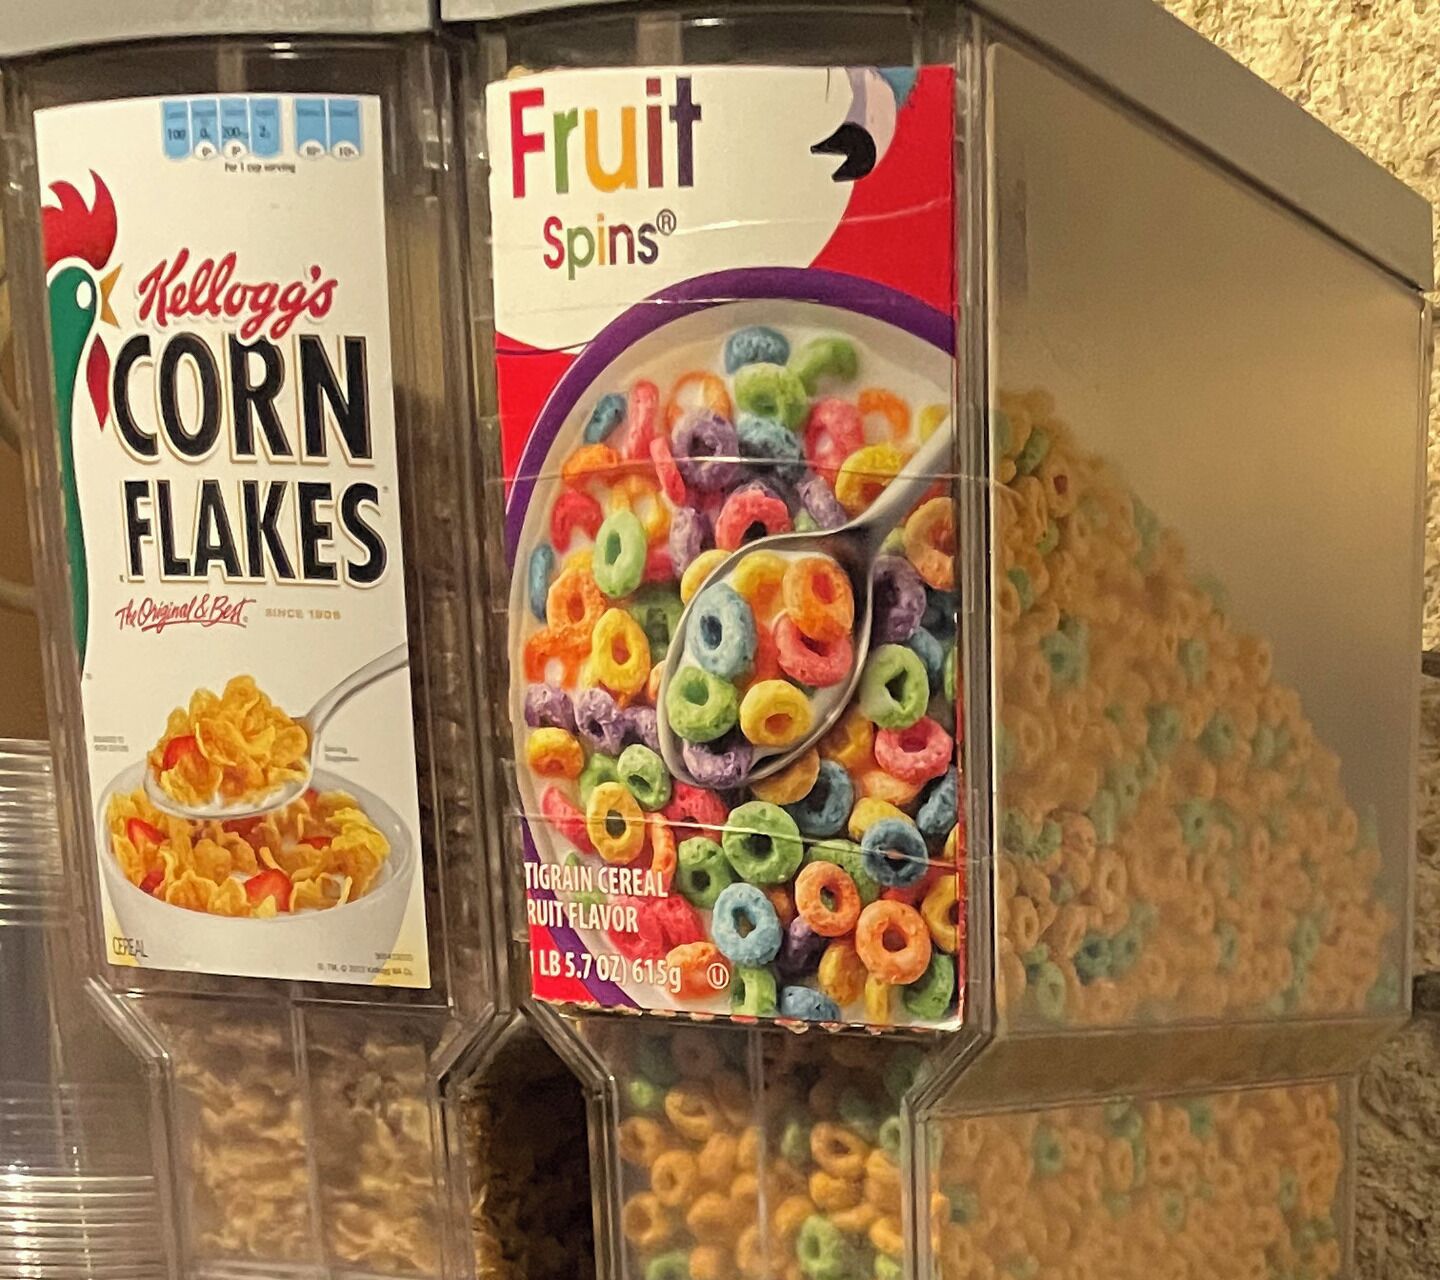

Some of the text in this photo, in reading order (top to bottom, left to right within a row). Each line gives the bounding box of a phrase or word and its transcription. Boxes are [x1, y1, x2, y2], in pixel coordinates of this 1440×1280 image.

[509, 76, 701, 198] Fruit
[139, 247, 338, 339] Kellogg's
[114, 333, 374, 460] CORN
[123, 479, 389, 584] FLAKES
[137, 594, 198, 633] Original
[194, 593, 211, 622] &
[208, 595, 257, 625] Best
[265, 608, 303, 619] SINCE
[598, 866, 668, 898] CEREAL
[568, 903, 639, 933] FLAVOR
[540, 951, 561, 976] LB
[565, 952, 594, 980] 5.7
[596, 955, 627, 985] OZ)
[631, 958, 682, 993] 615g
